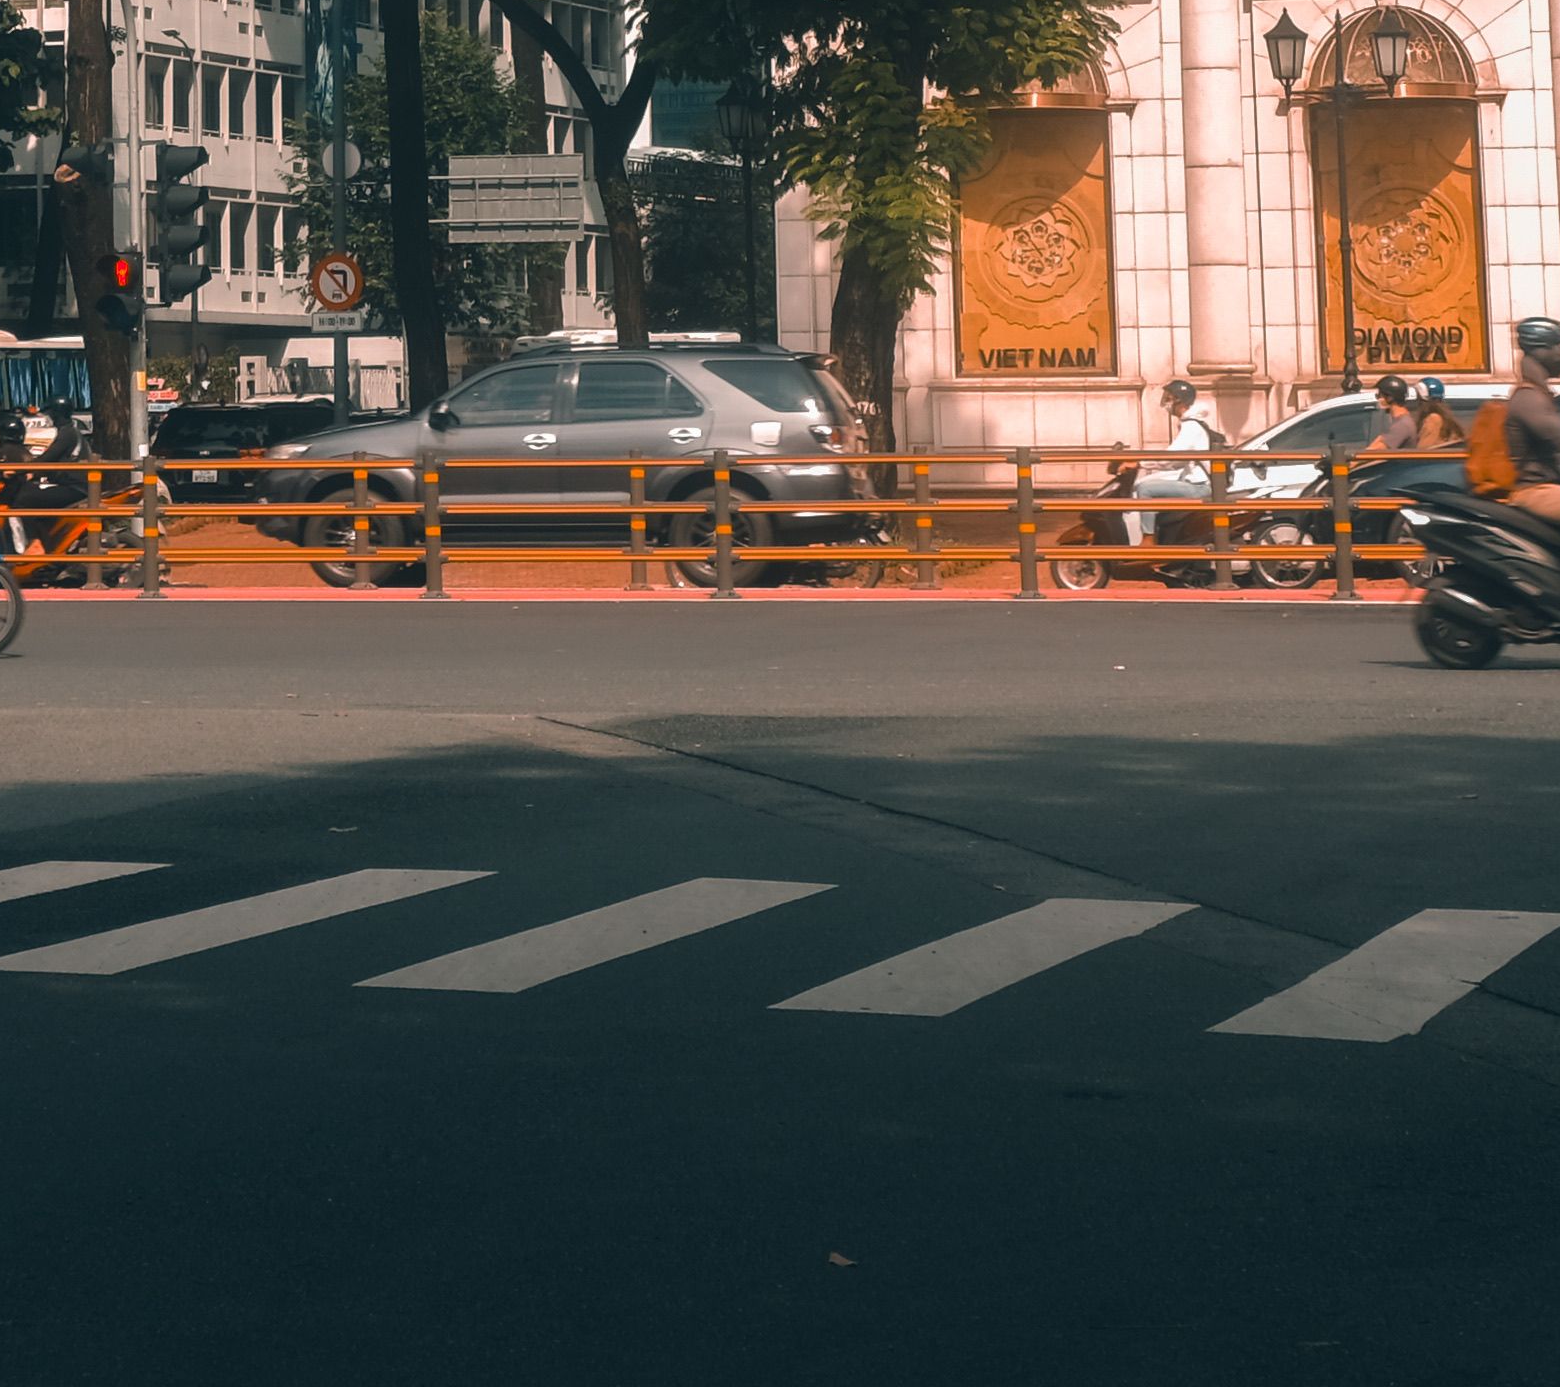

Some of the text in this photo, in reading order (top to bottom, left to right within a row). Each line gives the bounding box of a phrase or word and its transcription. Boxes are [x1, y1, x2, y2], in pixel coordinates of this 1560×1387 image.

[1353, 326, 1464, 346] DIAMOND
[979, 348, 1096, 368] VIET NAM
[1367, 346, 1448, 365] PLAZA
